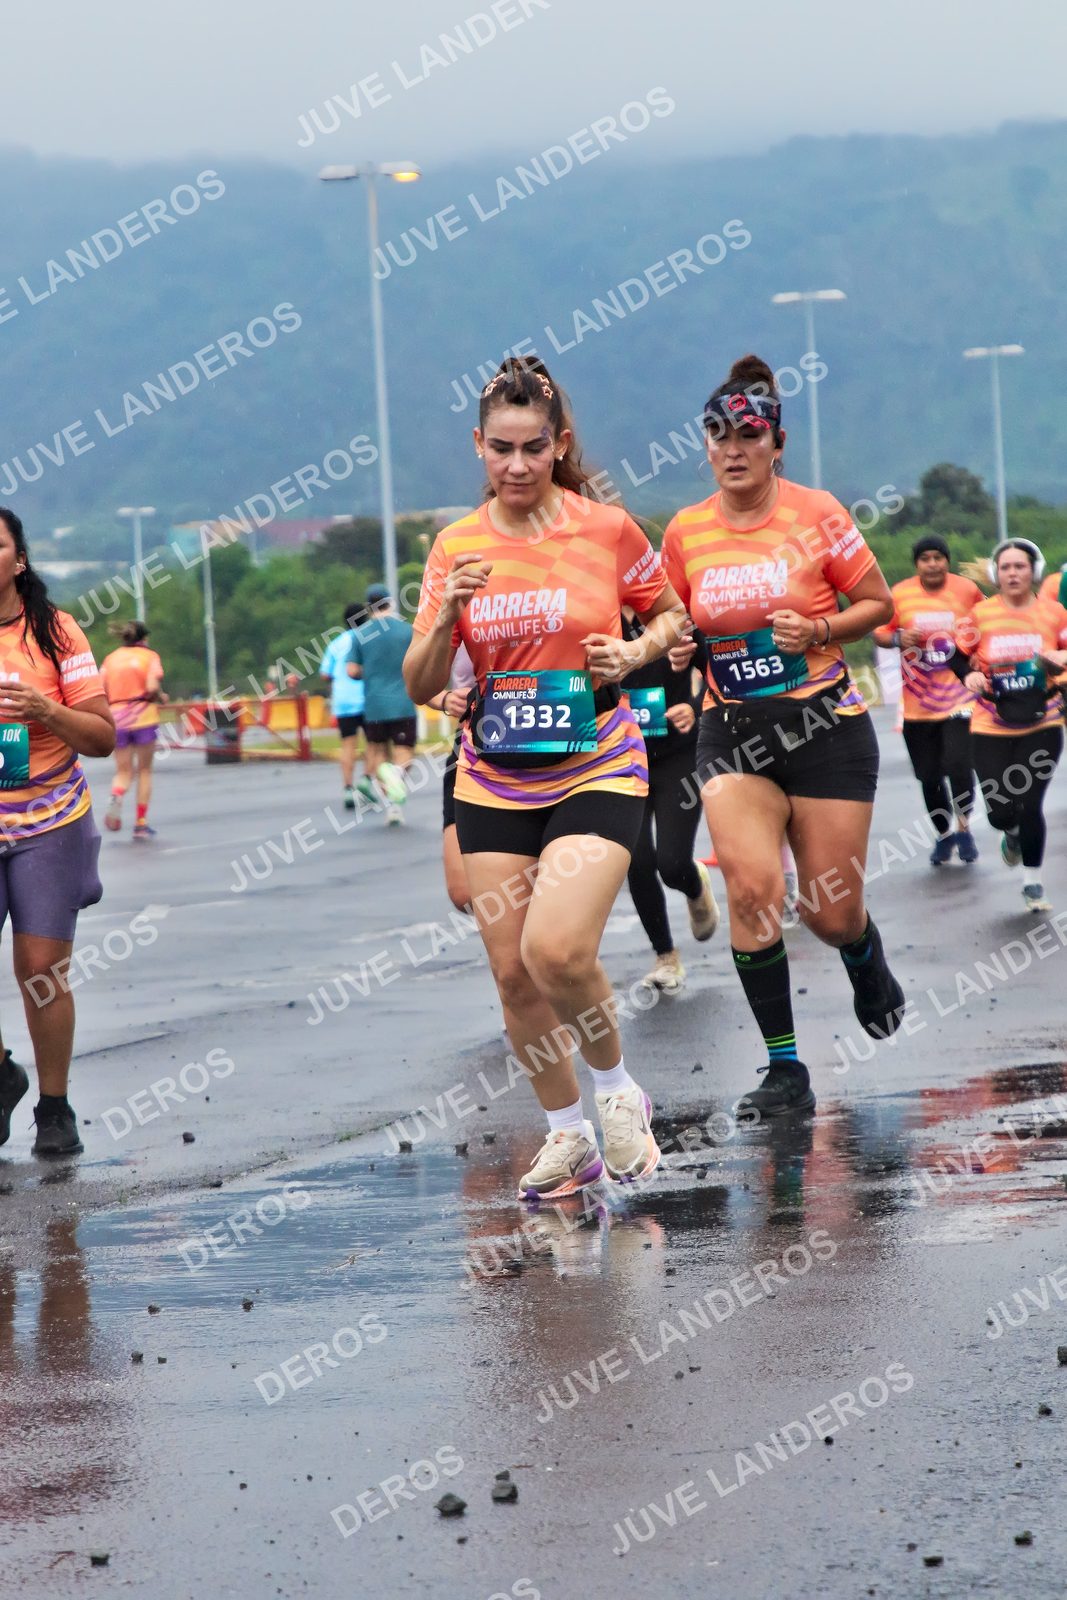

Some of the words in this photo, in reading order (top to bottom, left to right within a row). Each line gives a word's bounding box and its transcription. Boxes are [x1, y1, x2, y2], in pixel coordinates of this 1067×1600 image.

[702, 559, 788, 590] CARRERA
[470, 588, 567, 624] CARRERA
[698, 585, 767, 605] OMNILIFE
[471, 618, 541, 642] OMNILIFE
[712, 640, 747, 654] CARRERA
[728, 655, 784, 681] 1563
[492, 690, 526, 700] OMNILIFE
[494, 677, 538, 691] CARRERA
[568, 676, 586, 692] 10K
[506, 704, 571, 728] 1332
[2, 728, 21, 742] 10K
